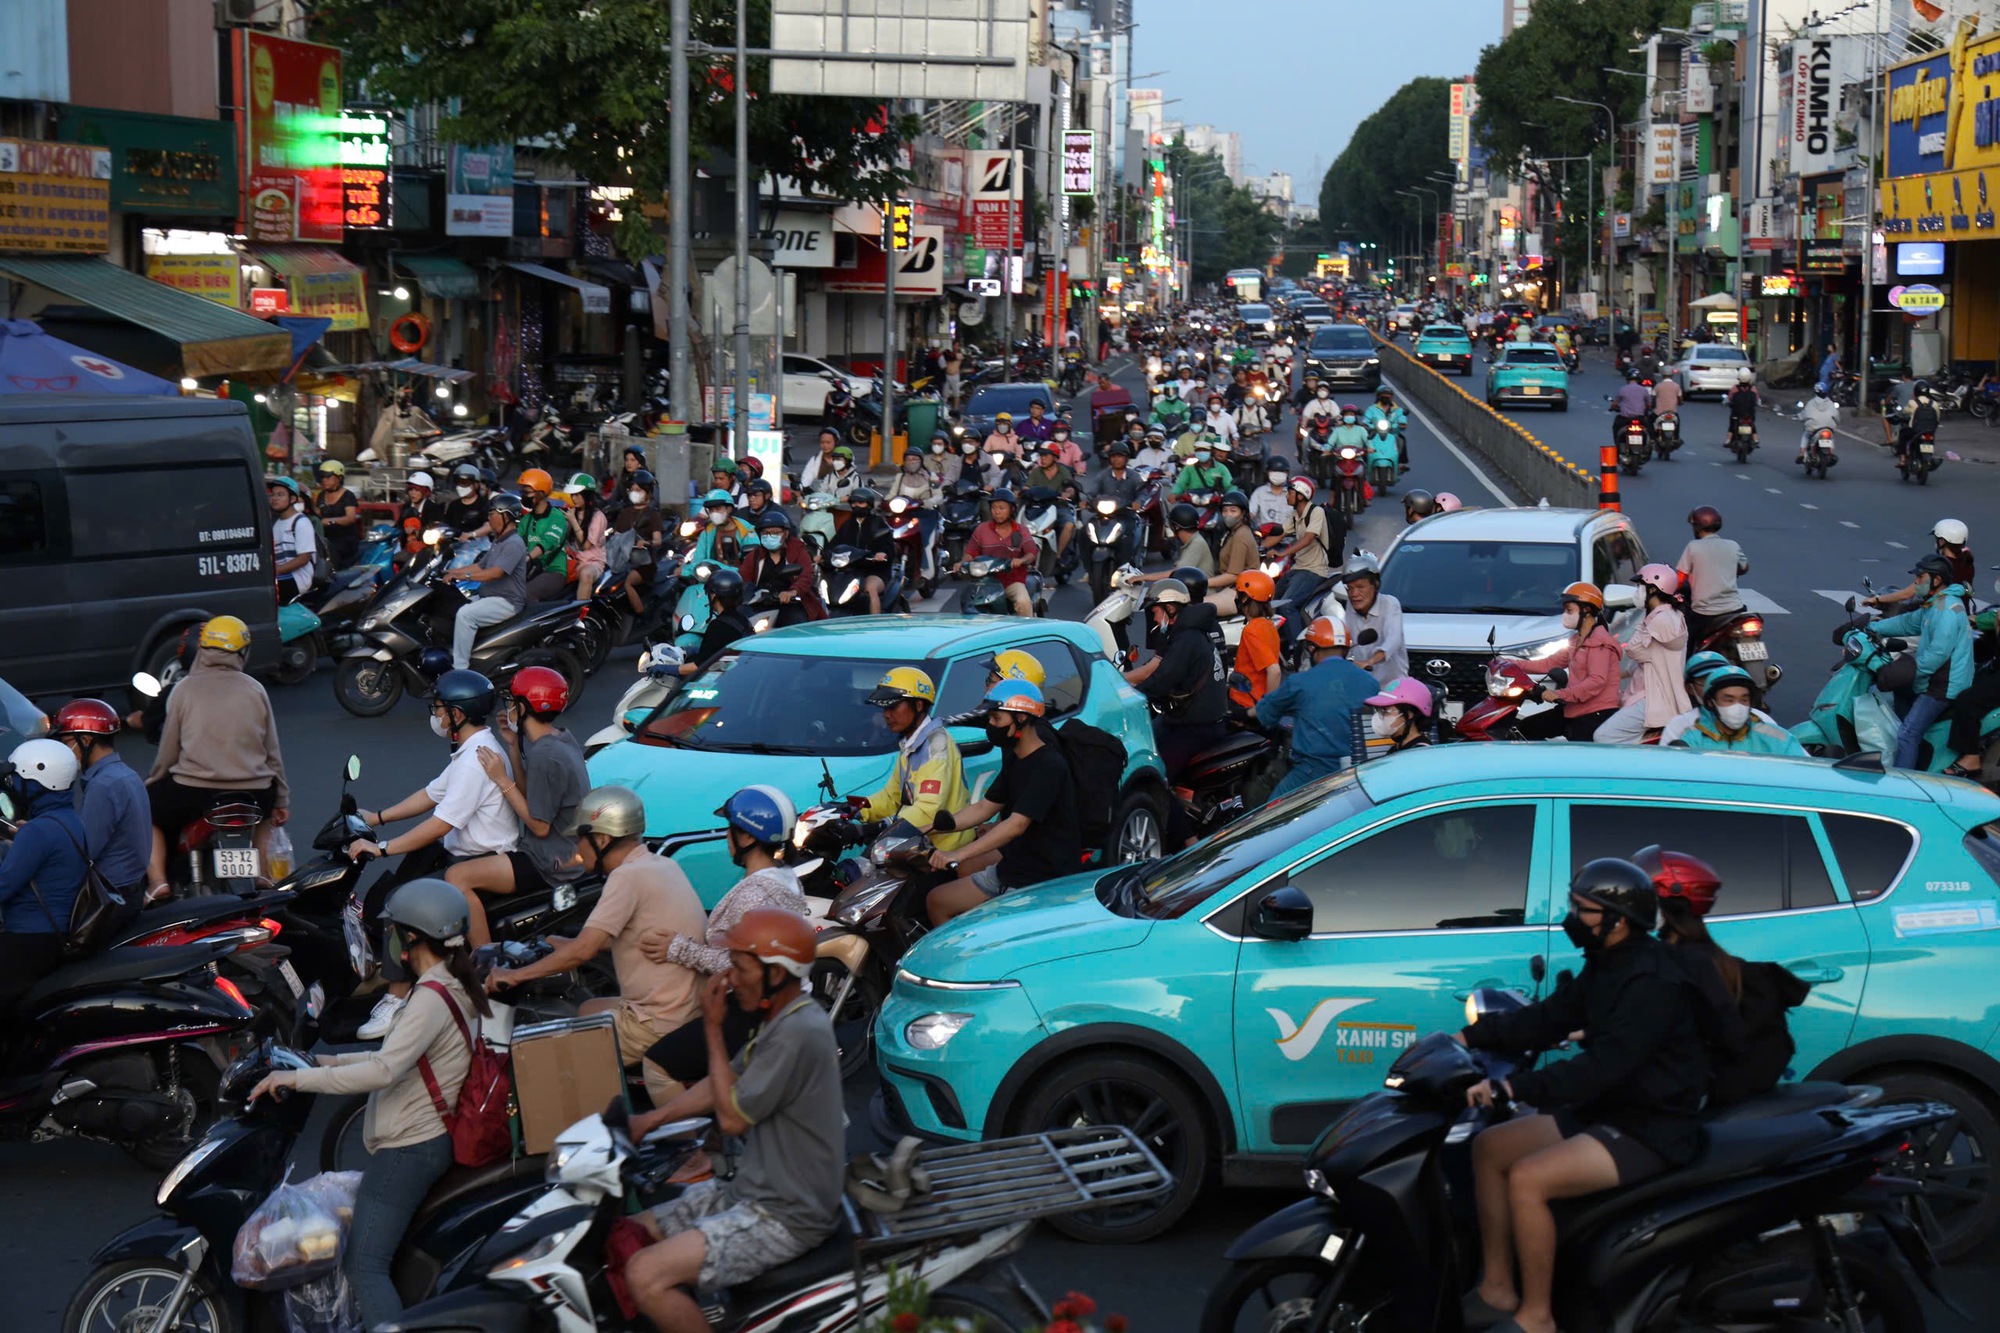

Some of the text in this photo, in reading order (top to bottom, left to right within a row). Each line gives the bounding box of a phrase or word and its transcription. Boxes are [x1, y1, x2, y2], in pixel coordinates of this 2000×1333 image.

[1797, 81, 1807, 96] XE
[1808, 41, 1831, 155] KUMHO
[1795, 98, 1806, 143] KUMHO
[199, 553, 260, 576] 51L-83874
[221, 851, 252, 862] 53-X2
[222, 864, 253, 875] 9002
[1336, 1029, 1388, 1047] XANH
[1336, 1049, 1373, 1063] TAXI
